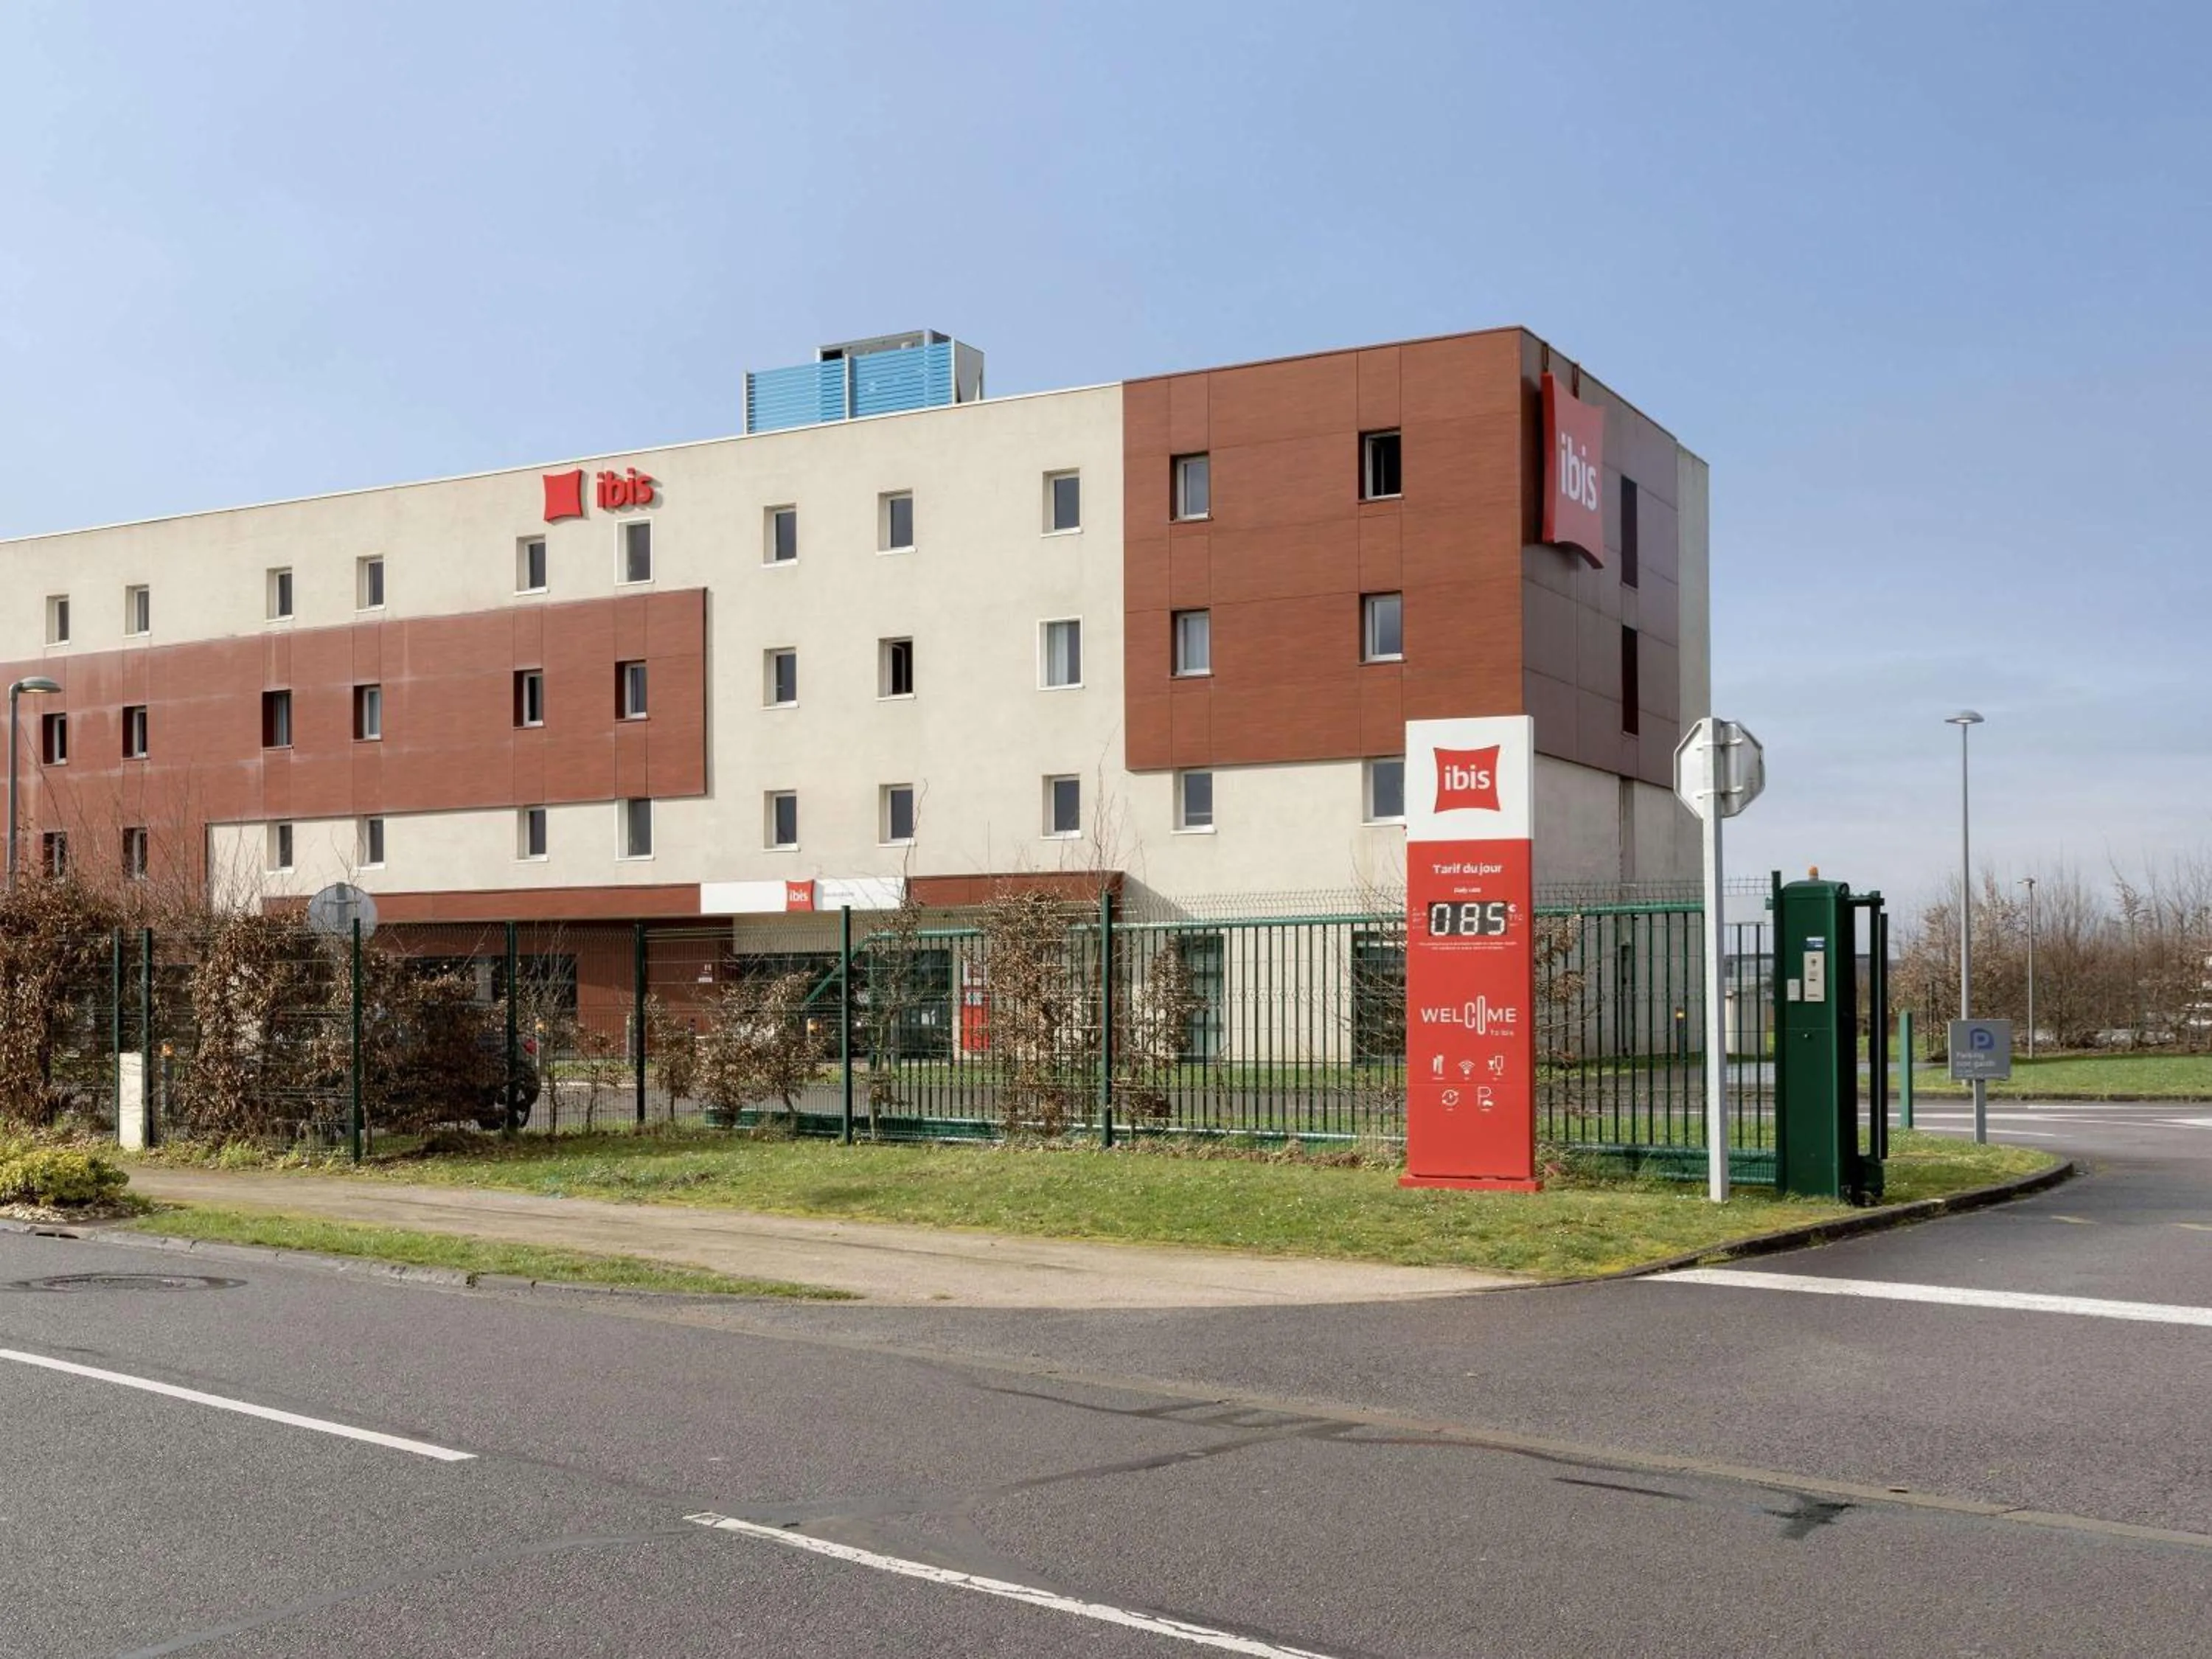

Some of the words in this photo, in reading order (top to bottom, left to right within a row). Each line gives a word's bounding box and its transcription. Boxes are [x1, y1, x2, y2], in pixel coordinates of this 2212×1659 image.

[1560, 431, 1597, 510] ibis
[597, 467, 654, 509] ibis
[1444, 764, 1490, 791] ibis
[1433, 863, 1461, 874] Tarif
[1463, 863, 1477, 874] du
[1478, 862, 1502, 876] jour
[789, 889, 809, 902] ibis
[1430, 902, 1505, 936] 085
[1421, 995, 1517, 1035] WELCOME
